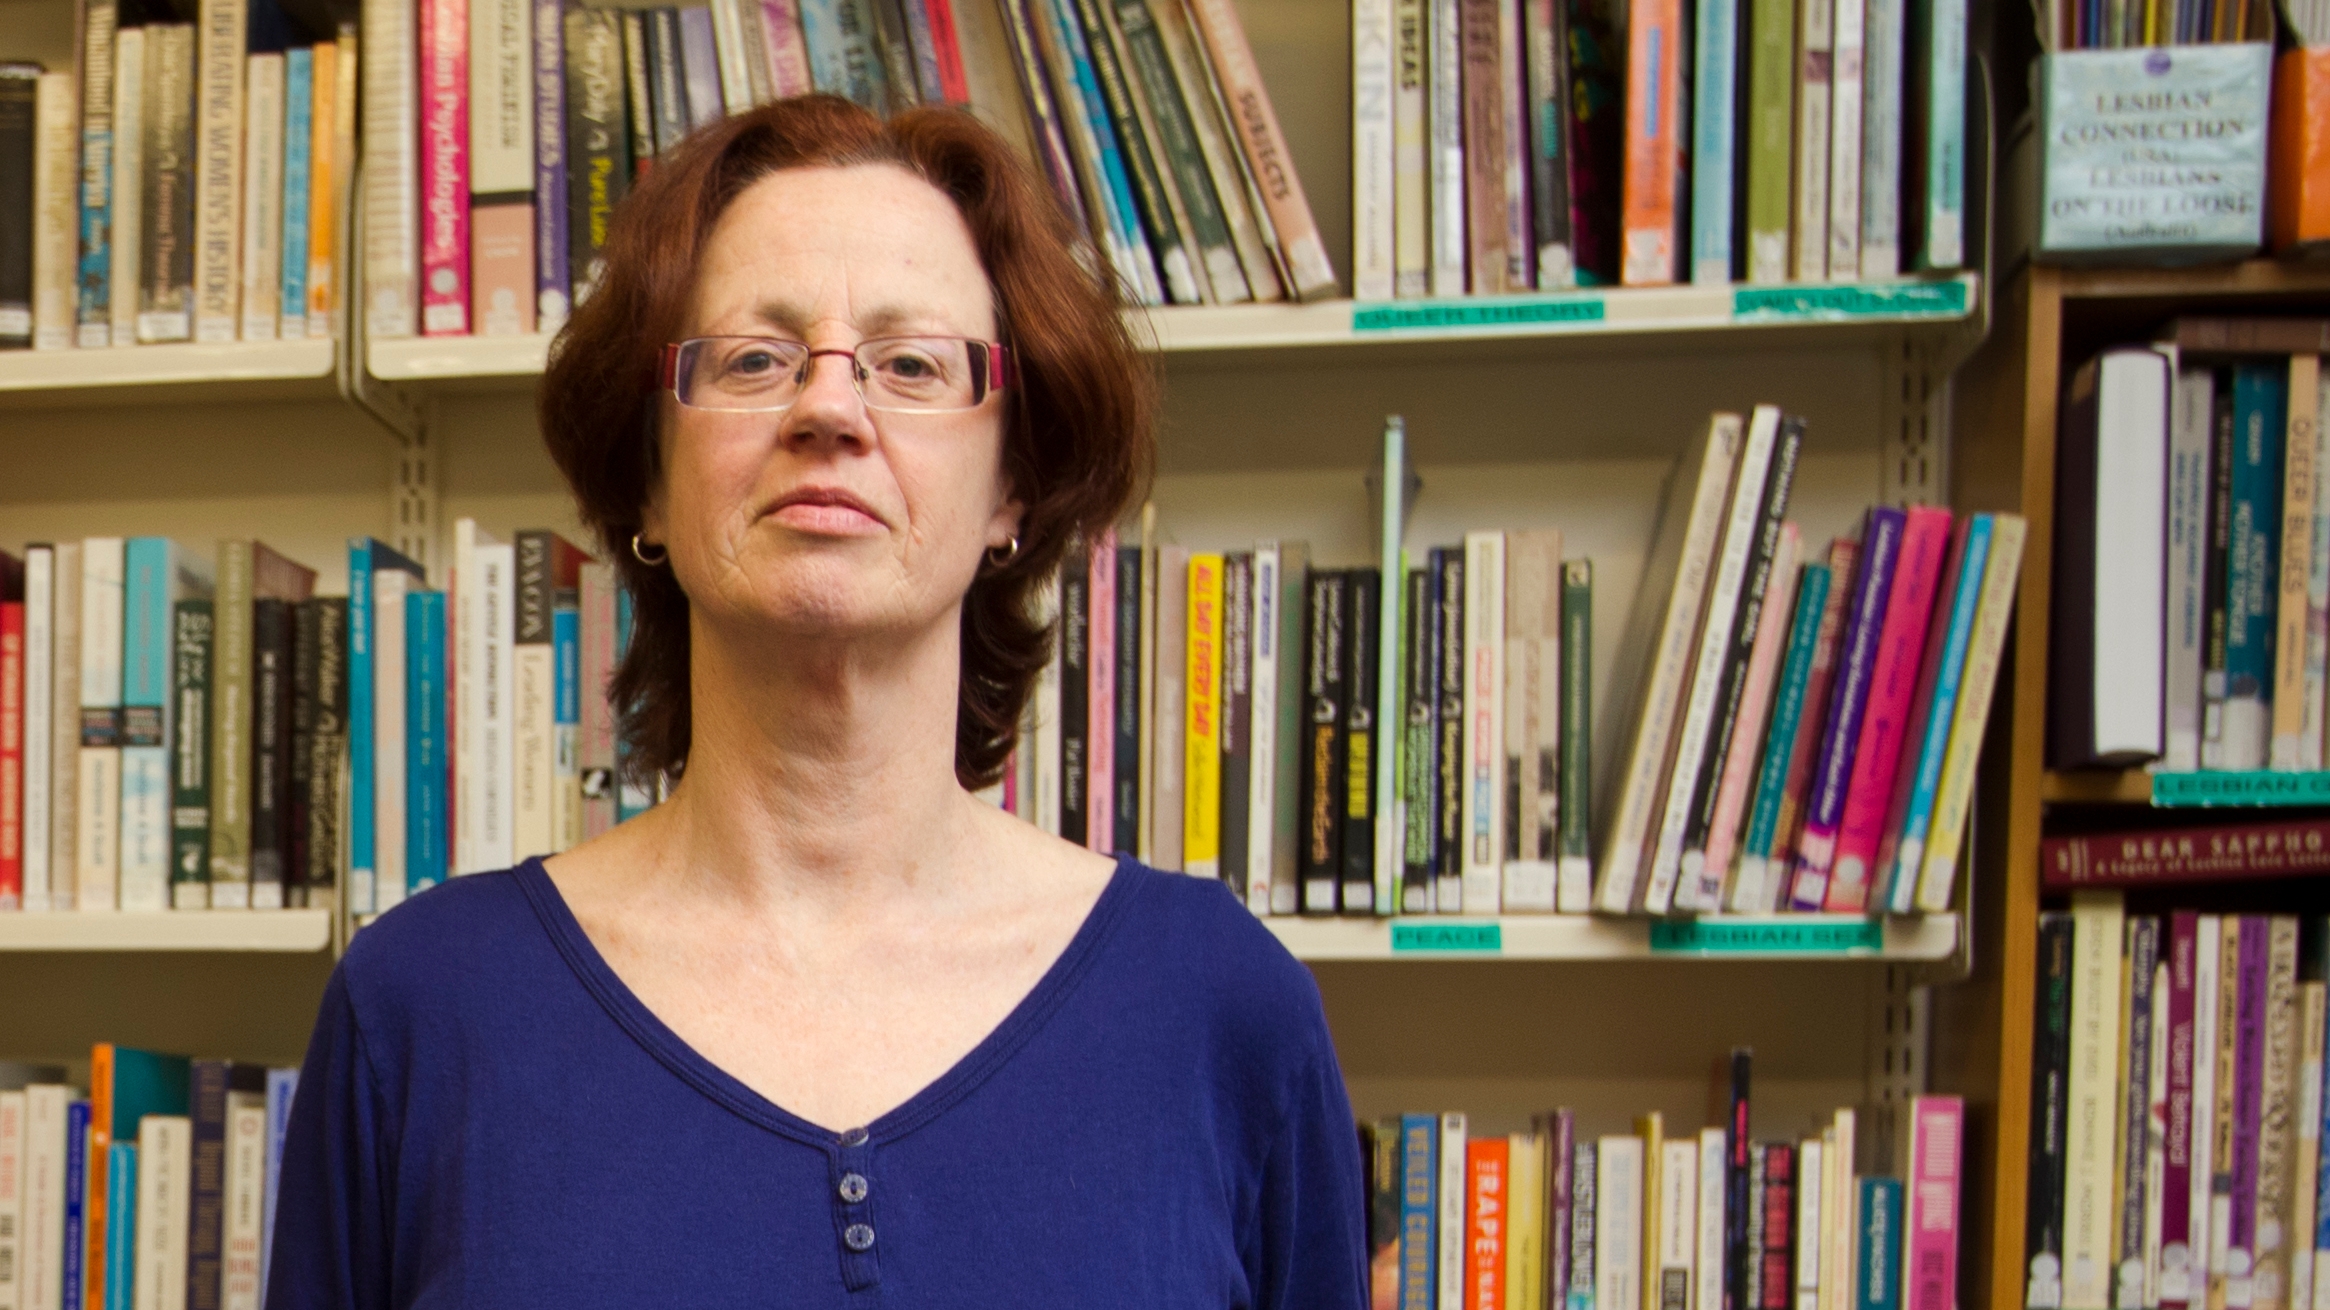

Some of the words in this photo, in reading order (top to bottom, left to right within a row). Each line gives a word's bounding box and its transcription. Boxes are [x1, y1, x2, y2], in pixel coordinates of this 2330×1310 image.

[207, 2, 235, 119] LIBERATING
[579, 25, 611, 75] Mary
[1399, 14, 1419, 91] IDEAS
[537, 73, 561, 167] STUDIES
[580, 76, 611, 123] Daly
[2095, 90, 2213, 112] LESBIAN
[1234, 87, 1294, 203] SUBJECTS
[2060, 118, 2244, 146] CONNECTION
[205, 124, 233, 225] WOMEN'S
[428, 91, 462, 250] Psychologies
[589, 156, 614, 203] Pure
[2089, 167, 2222, 188] LESBIANS
[2051, 199, 2089, 218] ON
[2102, 197, 2150, 216] THE
[2163, 193, 2256, 215] LOOSE
[204, 229, 231, 313] HISTORY
[1356, 307, 1466, 327] QUEER
[1476, 301, 1599, 322] THEORY
[1768, 432, 1801, 519] NOTHING
[2287, 415, 2313, 503] QUEER
[1759, 518, 1781, 558] BUT
[1868, 519, 1893, 572] Lesbian
[2230, 499, 2251, 573] MOTHER
[2282, 512, 2309, 596] BLUES
[1194, 563, 1214, 595] ALL
[1749, 559, 1770, 599] THE
[2246, 531, 2268, 616] ANOTHER
[318, 603, 340, 645] Alice
[1193, 599, 1213, 635] DAY
[1737, 600, 1761, 647] GIRL
[2227, 577, 2247, 648] TONGUE
[1192, 638, 1212, 697] EVERY
[1846, 623, 1871, 669] Loving
[318, 646, 340, 708] Walker
[521, 654, 544, 730] Leading
[1192, 701, 1211, 740] DAY
[522, 734, 543, 812] Women
[1313, 724, 1336, 785] Reclaim
[2157, 778, 2300, 796] LESBIAN
[1310, 807, 1333, 864] Earth
[2121, 837, 2194, 861] DEAR
[2210, 828, 2323, 855] SAPPHO
[2287, 849, 2330, 866] Lette
[1396, 929, 1496, 947] PEACE
[1670, 928, 1802, 946] LESBIAN
[2085, 1019, 2100, 1040] BY
[2170, 1019, 2192, 1086] Violent
[2167, 1089, 2190, 1166] Betrayal
[1405, 1125, 1430, 1205] VEILED
[1473, 1173, 1500, 1256] RAPE
